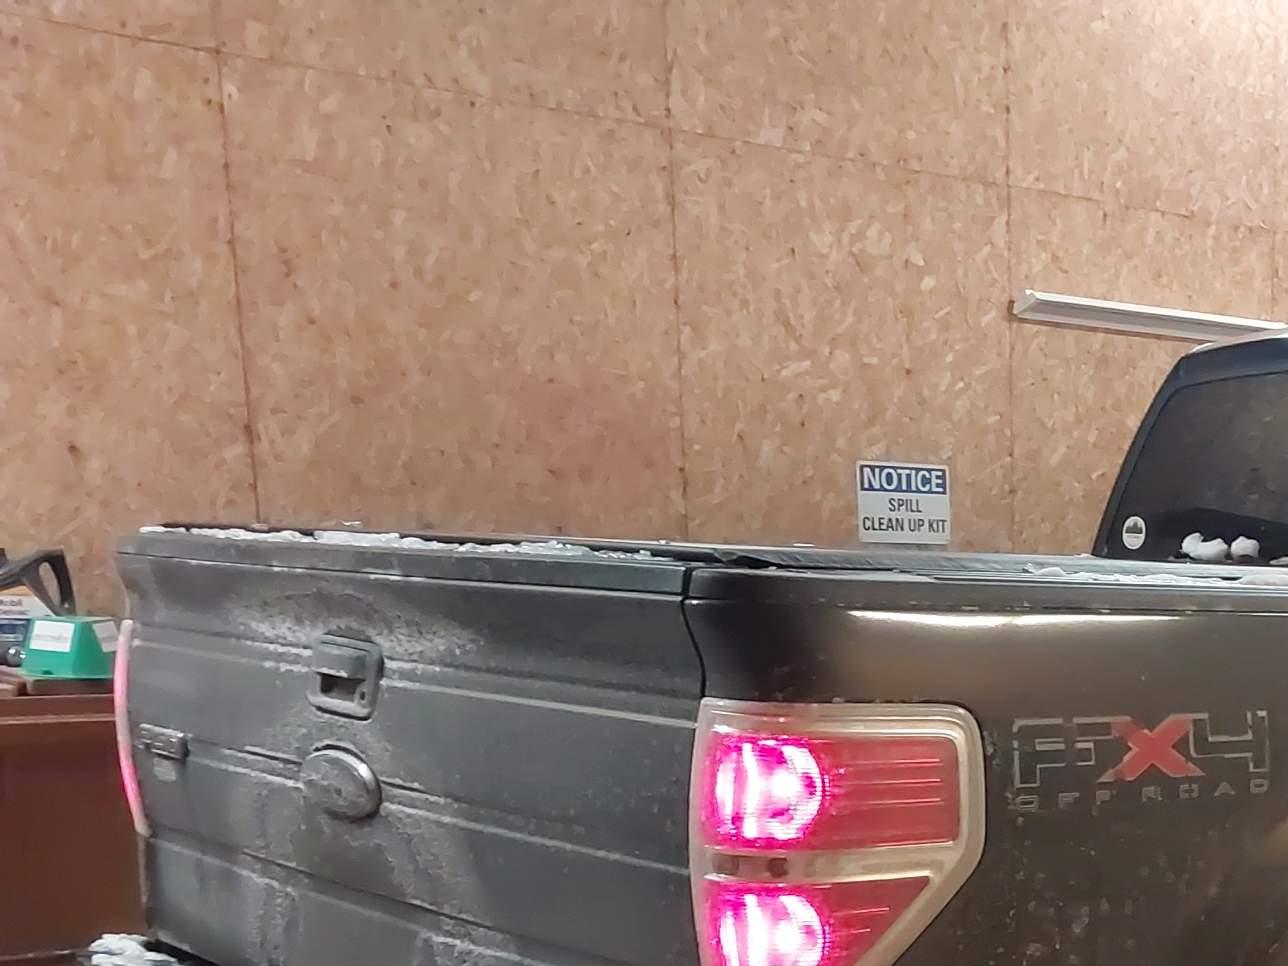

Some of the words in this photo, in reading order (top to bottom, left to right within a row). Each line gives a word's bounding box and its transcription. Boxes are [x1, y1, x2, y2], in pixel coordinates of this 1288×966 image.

[863, 466, 944, 492] NOTICE
[888, 497, 922, 513] SPILL
[862, 516, 905, 532] CLEAN
[908, 518, 925, 532] UP
[928, 519, 948, 533] KIT
[1012, 710, 1270, 788] FX4
